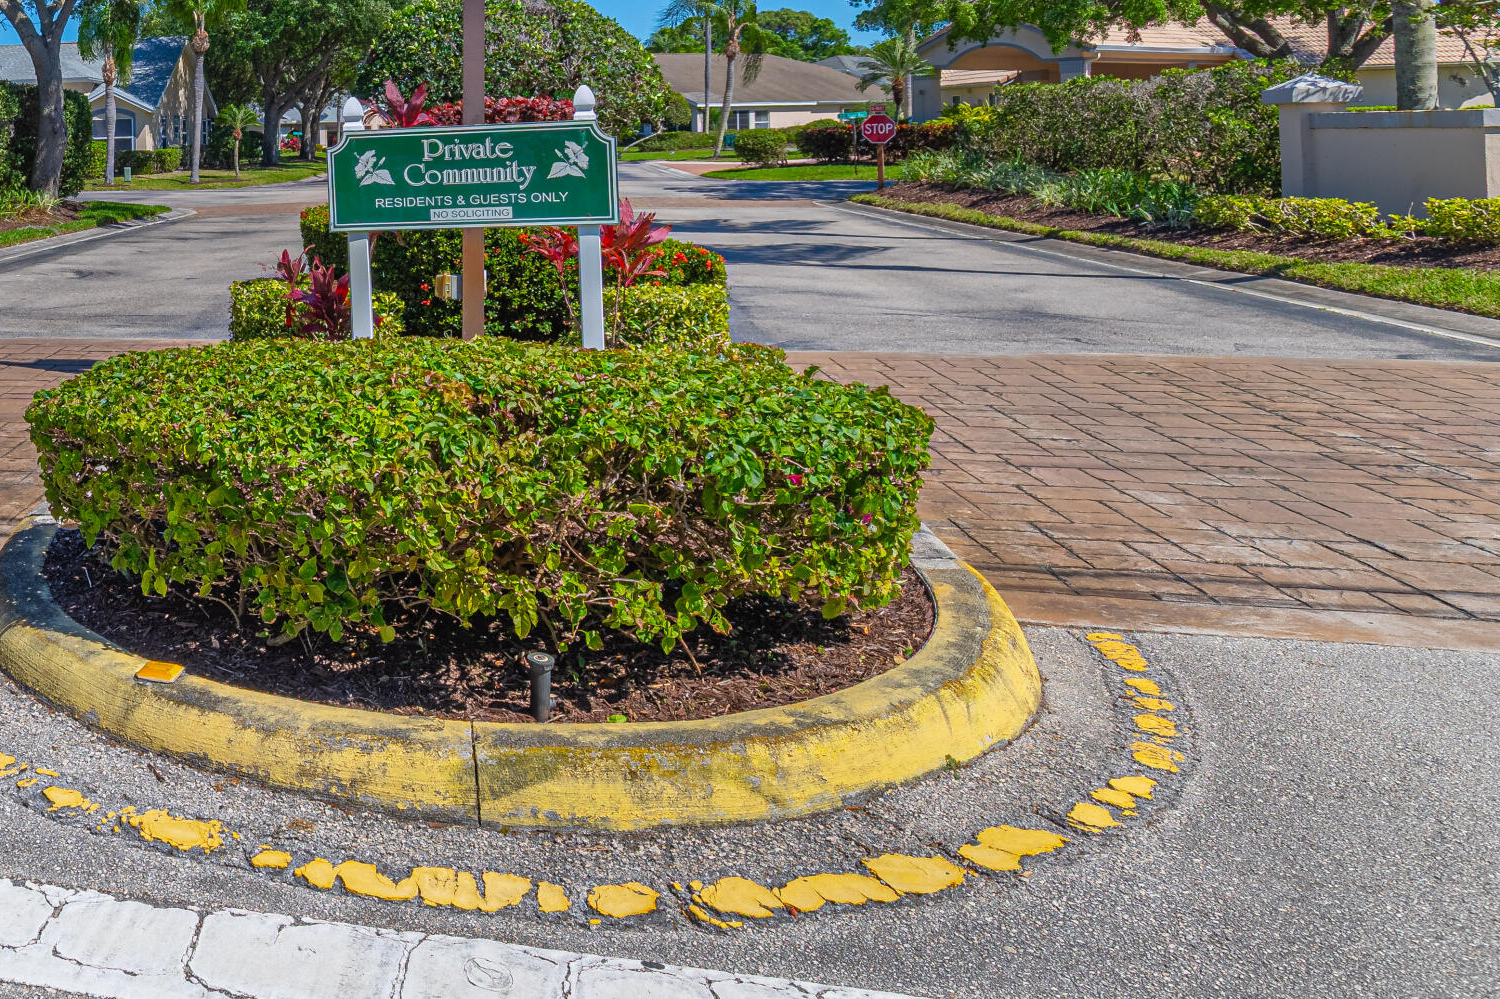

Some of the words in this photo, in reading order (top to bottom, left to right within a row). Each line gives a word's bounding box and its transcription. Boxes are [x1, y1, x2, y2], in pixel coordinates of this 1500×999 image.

[865, 123, 893, 134] STOP
[421, 137, 514, 162] Private
[403, 160, 537, 190] Community
[375, 195, 453, 209] RESIDENTS
[456, 194, 466, 206] &
[469, 193, 527, 205] GUESTS
[530, 191, 569, 203] ONLY
[433, 210, 449, 219] NO
[451, 208, 510, 218] SOLICITING
